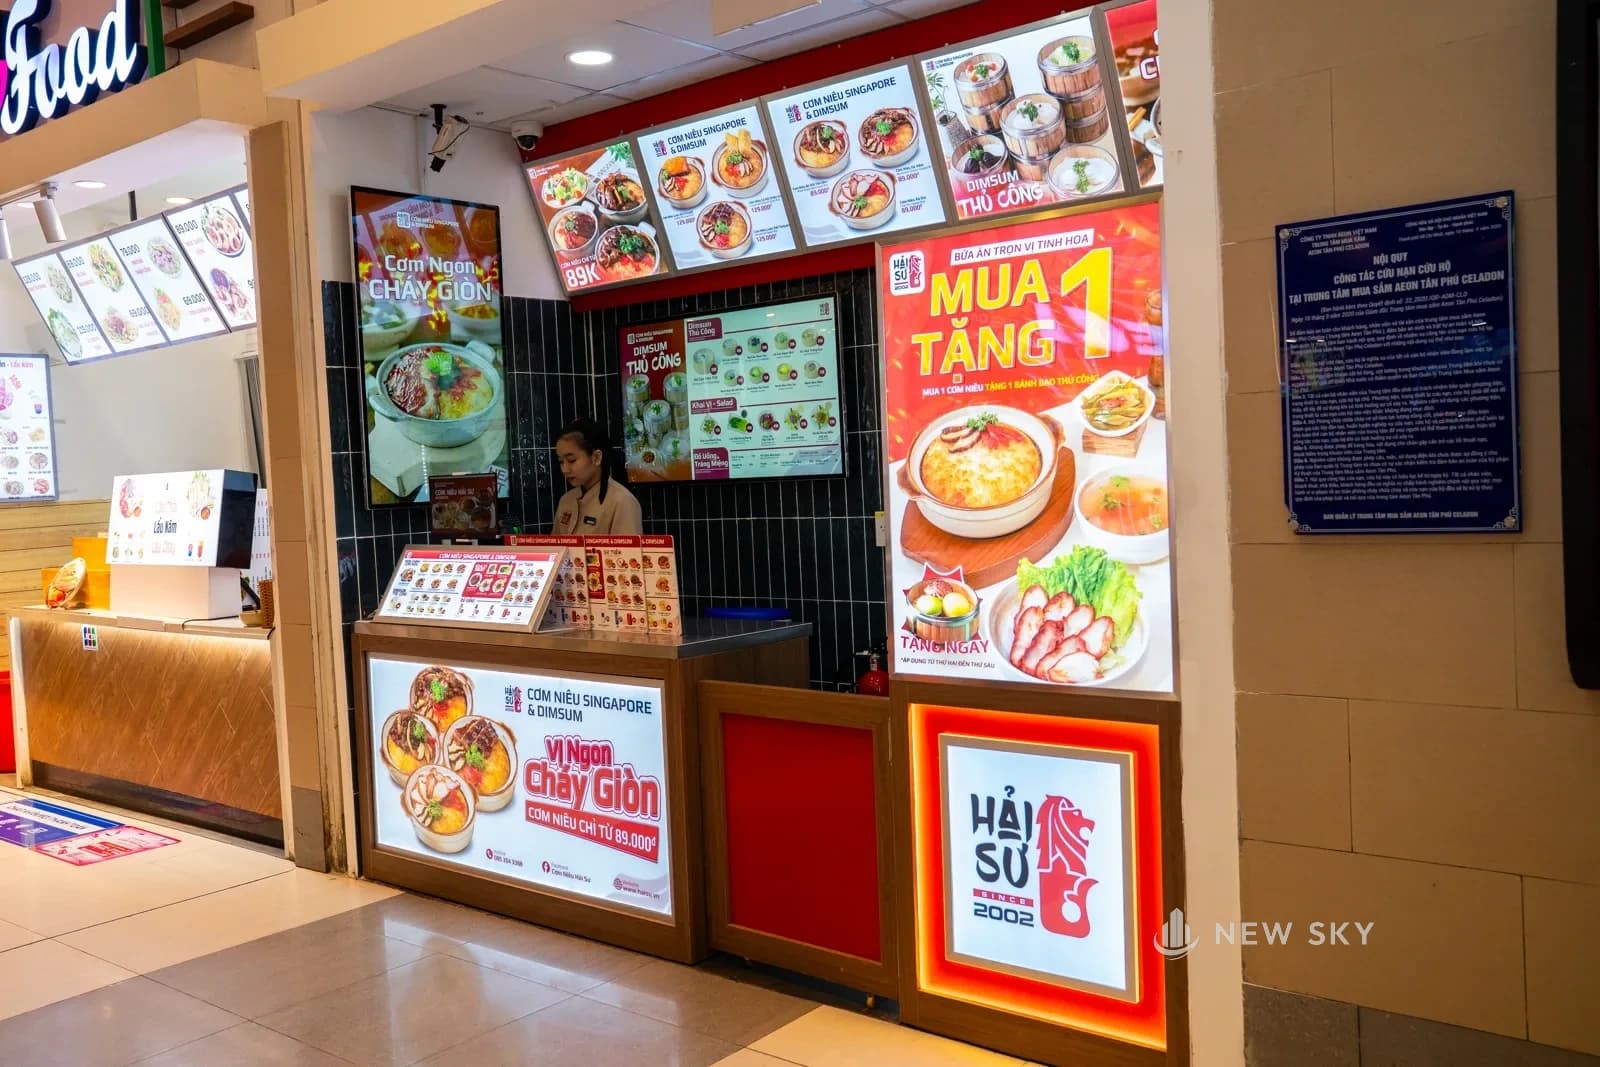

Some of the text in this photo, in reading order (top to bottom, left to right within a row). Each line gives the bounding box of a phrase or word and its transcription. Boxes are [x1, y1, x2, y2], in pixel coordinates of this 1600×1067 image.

[1, 0, 137, 134] Food
[803, 76, 897, 110] CƠM NIÊU SINGAPORE
[806, 101, 849, 120] & DIMSUM
[668, 117, 747, 145] CƠM NIÊU SINGAPORE
[670, 138, 708, 155] & DIMSUM
[966, 169, 1020, 192] DIMSUM
[958, 182, 1044, 217] THỦ CÔNG
[954, 251, 974, 262] BỮA
[993, 244, 1022, 258] TRỌN
[1024, 241, 1035, 253] VỊ
[1037, 237, 1062, 250] TINH
[1066, 234, 1089, 246] HOA
[1372, 252, 1408, 266] NỘI QUY
[384, 254, 475, 278] Cơm Ngon
[565, 262, 602, 288] 89K
[1334, 259, 1452, 285] CÔNG TÁC CỨU NẠN CỨU HỘ
[368, 274, 492, 300] CHÁY GIÒN
[930, 259, 1050, 316] MUA
[1288, 270, 1505, 306] TẠI TRUNG TÂM MUA SẮM AEON TÂN PHÚ CELADON
[1061, 247, 1113, 360] 1
[634, 341, 668, 356] DIMSUM
[911, 317, 1056, 384] TẶNG
[626, 351, 682, 376] THỦ CÔNG
[922, 388, 940, 396] MUA
[965, 382, 984, 393] NIÊU
[1038, 377, 1056, 387] BAO
[900, 636, 989, 654] TẶNG NGAY
[527, 688, 652, 714] CƠM NIÊU SINGAPORE
[528, 704, 583, 722] & DIMSUM
[566, 738, 612, 771] Ngon
[525, 760, 589, 811] Cháy
[528, 807, 550, 822] CƠM
[552, 812, 577, 830] NIÊU
[579, 817, 596, 836] CHỈ
[598, 823, 614, 840] TỪ
[970, 784, 1033, 843] HẢI
[975, 842, 1029, 889] SƯ
[981, 891, 1026, 905] SINCE
[974, 902, 1034, 928] 2002
